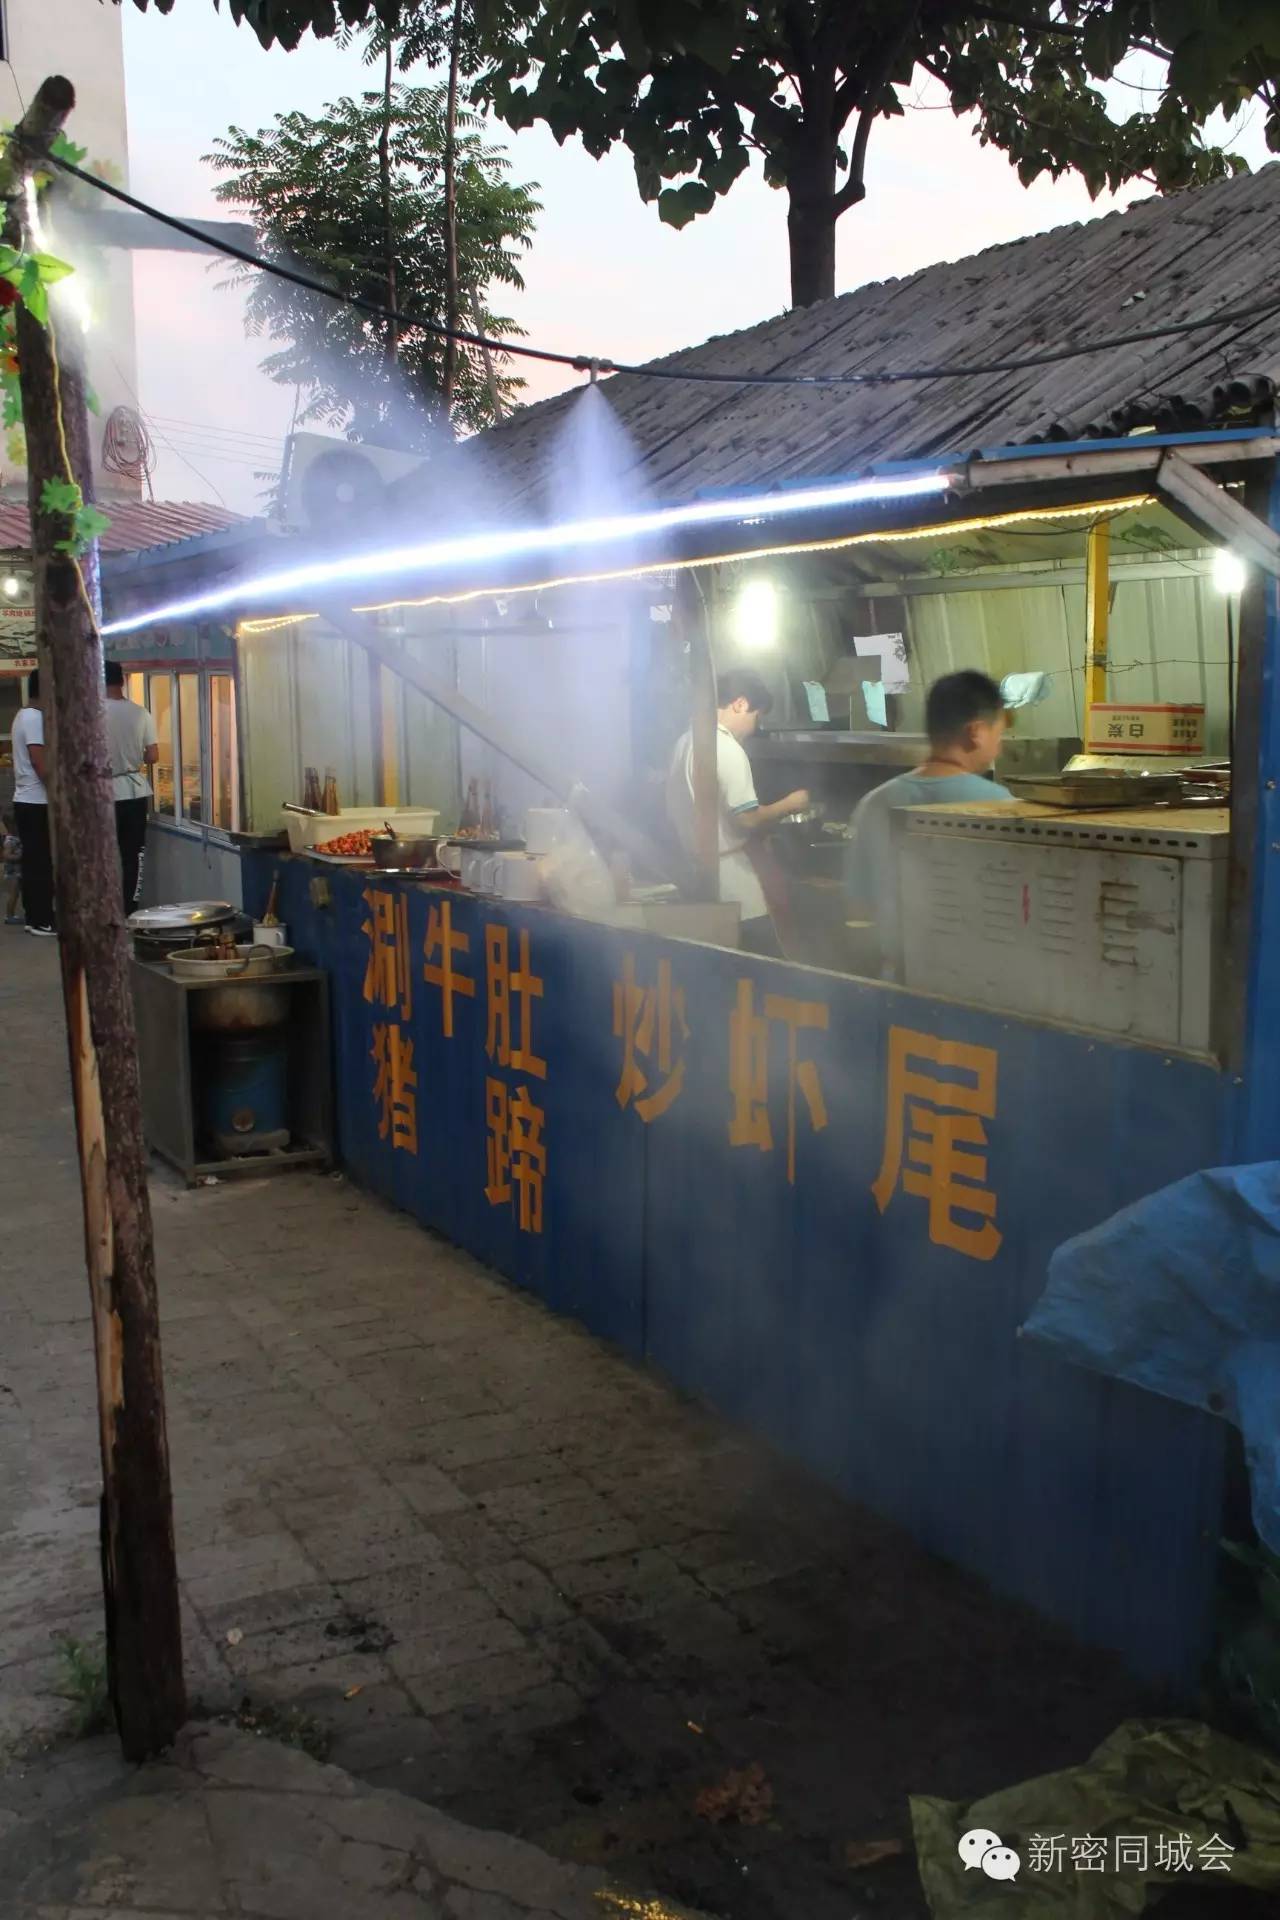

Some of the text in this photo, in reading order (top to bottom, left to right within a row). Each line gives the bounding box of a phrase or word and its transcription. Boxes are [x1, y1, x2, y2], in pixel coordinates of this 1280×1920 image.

[1107, 723, 1144, 738] 白炭
[362, 886, 547, 1081] 涮牛肚
[369, 1022, 547, 1234] 猪蹄
[611, 951, 1003, 1262] 炒虾尾
